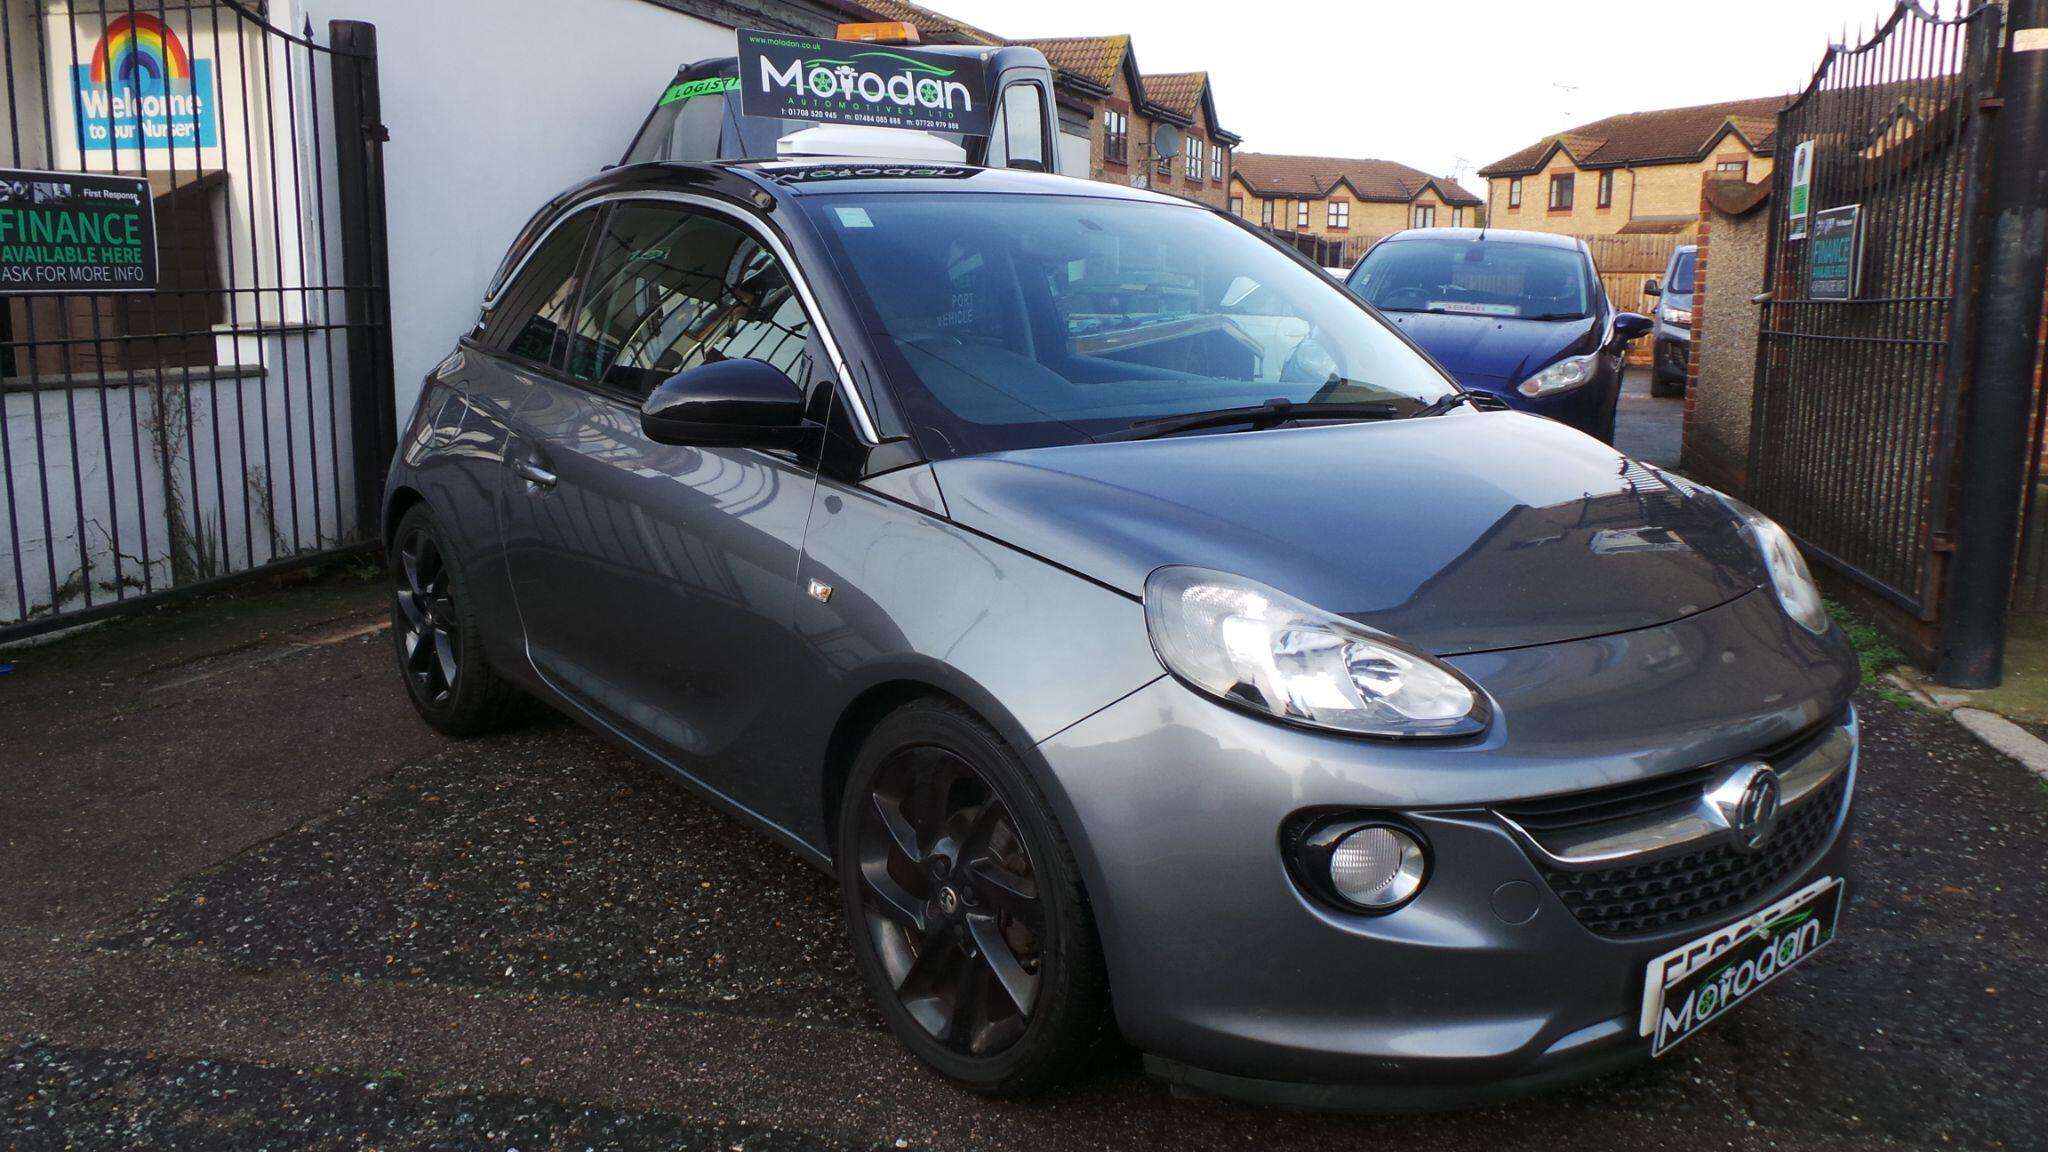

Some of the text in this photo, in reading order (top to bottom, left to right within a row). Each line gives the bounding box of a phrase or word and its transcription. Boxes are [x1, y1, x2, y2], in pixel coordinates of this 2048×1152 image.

[80, 87, 203, 119] Welcome
[788, 97, 954, 119] AUTOMOTIVES LTD
[788, 108, 809, 117] 01708
[825, 111, 837, 119] 945
[89, 123, 107, 140] to
[83, 188, 139, 201] First Response
[0, 208, 142, 245] FINANCE
[1, 245, 143, 264] AVAILABLE HERE
[1, 266, 144, 282] ASK FOR MORE INFO
